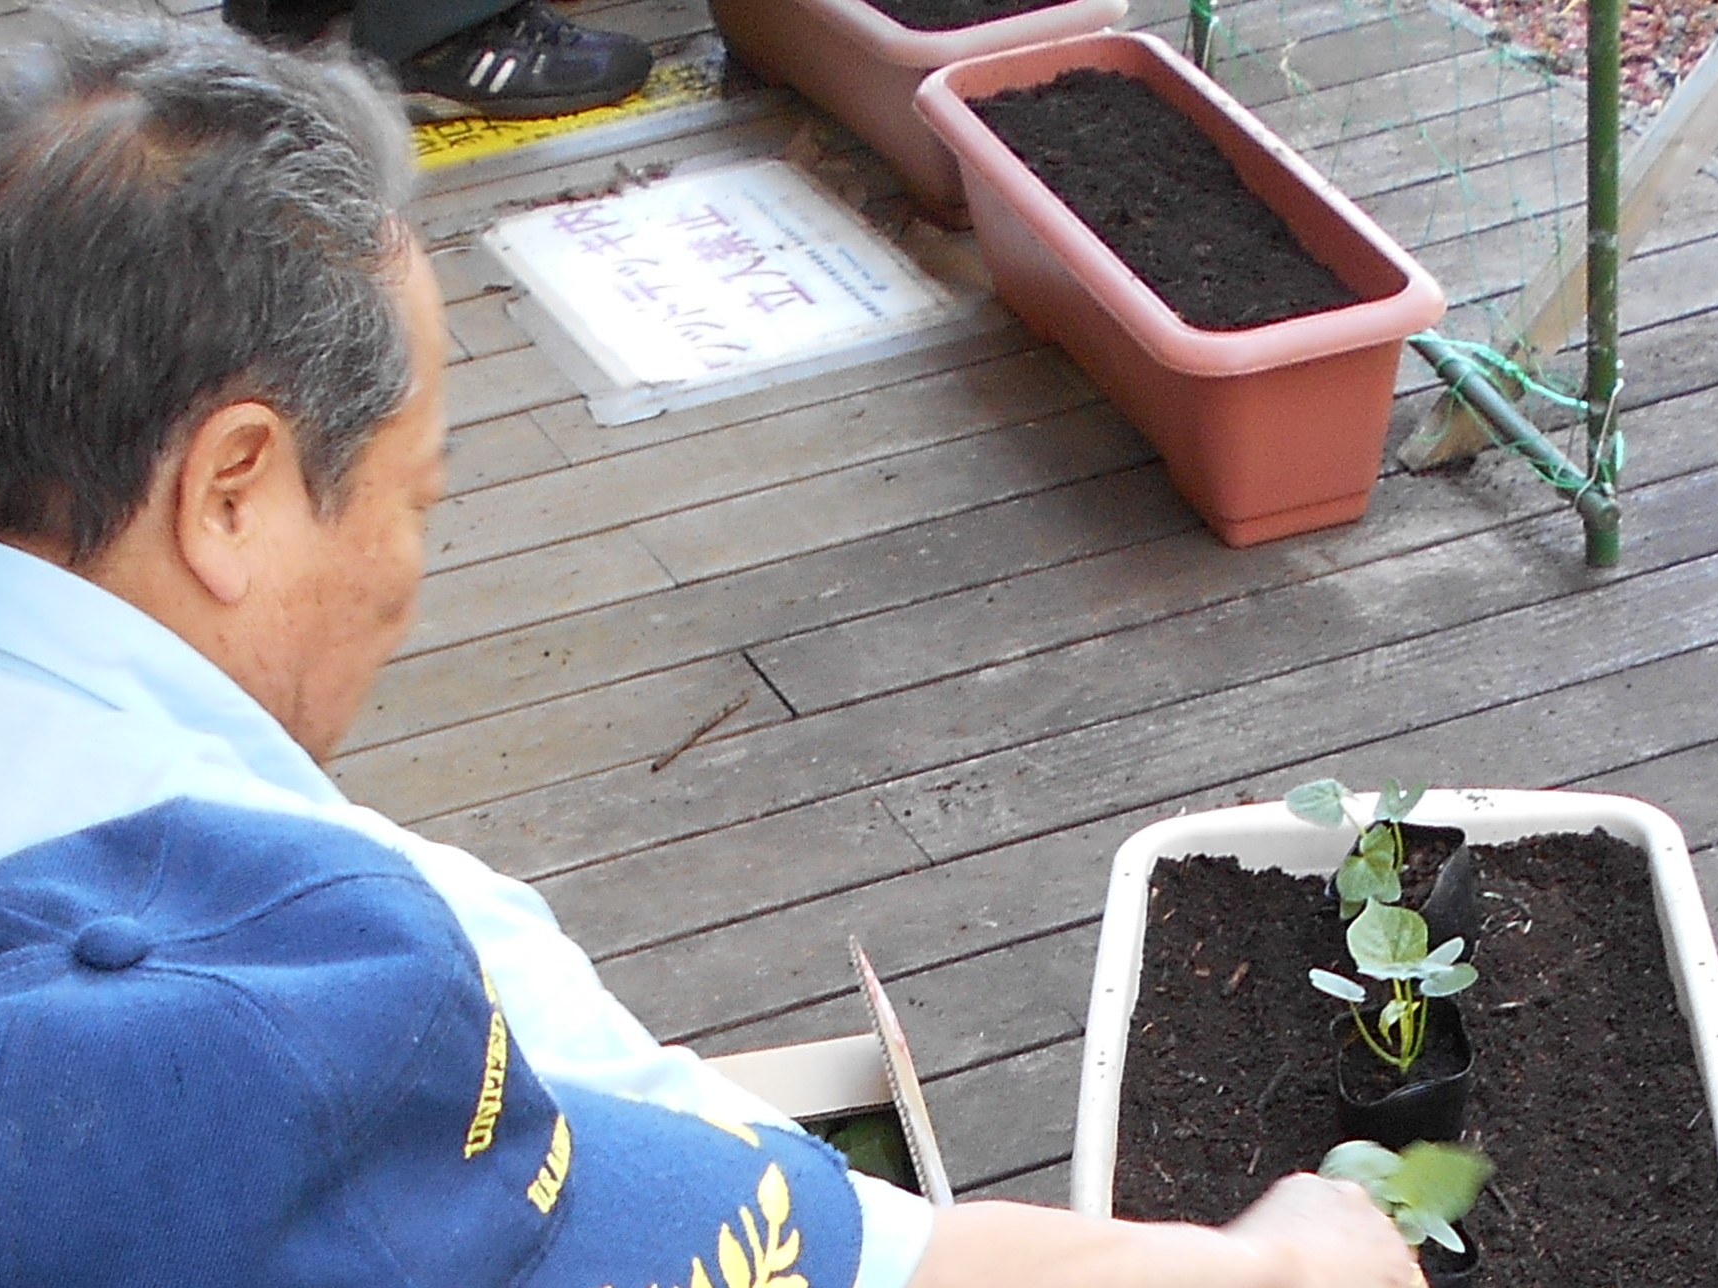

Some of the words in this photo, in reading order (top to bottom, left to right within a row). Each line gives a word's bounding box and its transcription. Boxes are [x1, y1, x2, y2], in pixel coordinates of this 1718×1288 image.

[665, 204, 817, 313] 立入禁止
[464, 1010, 508, 1160] UNITED
